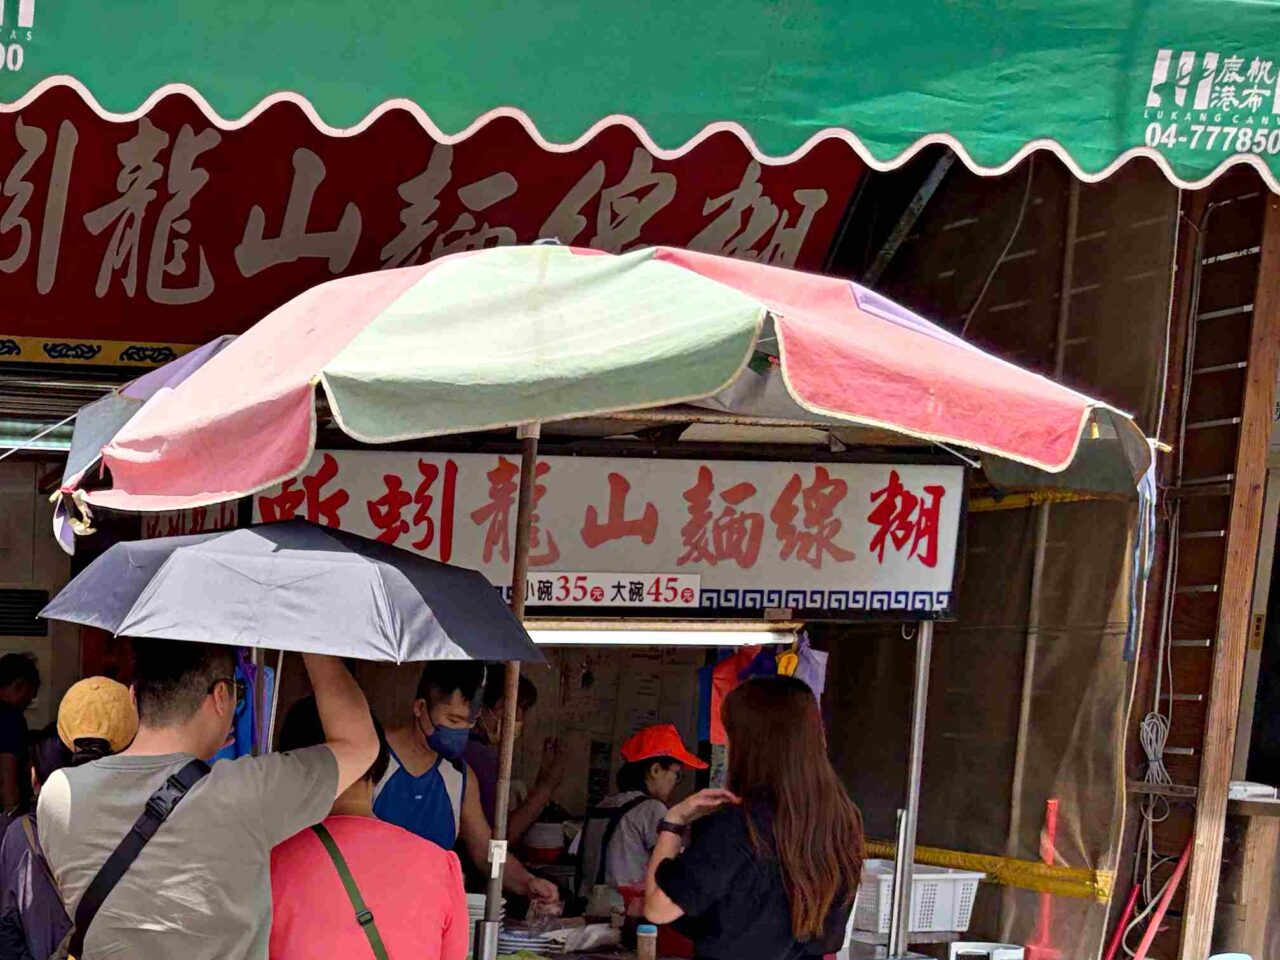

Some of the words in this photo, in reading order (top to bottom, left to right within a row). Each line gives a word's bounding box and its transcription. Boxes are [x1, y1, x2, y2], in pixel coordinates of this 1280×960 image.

[1144, 109, 1222, 122] LUKANG
[610, 576, 695, 604] 大碗45元
